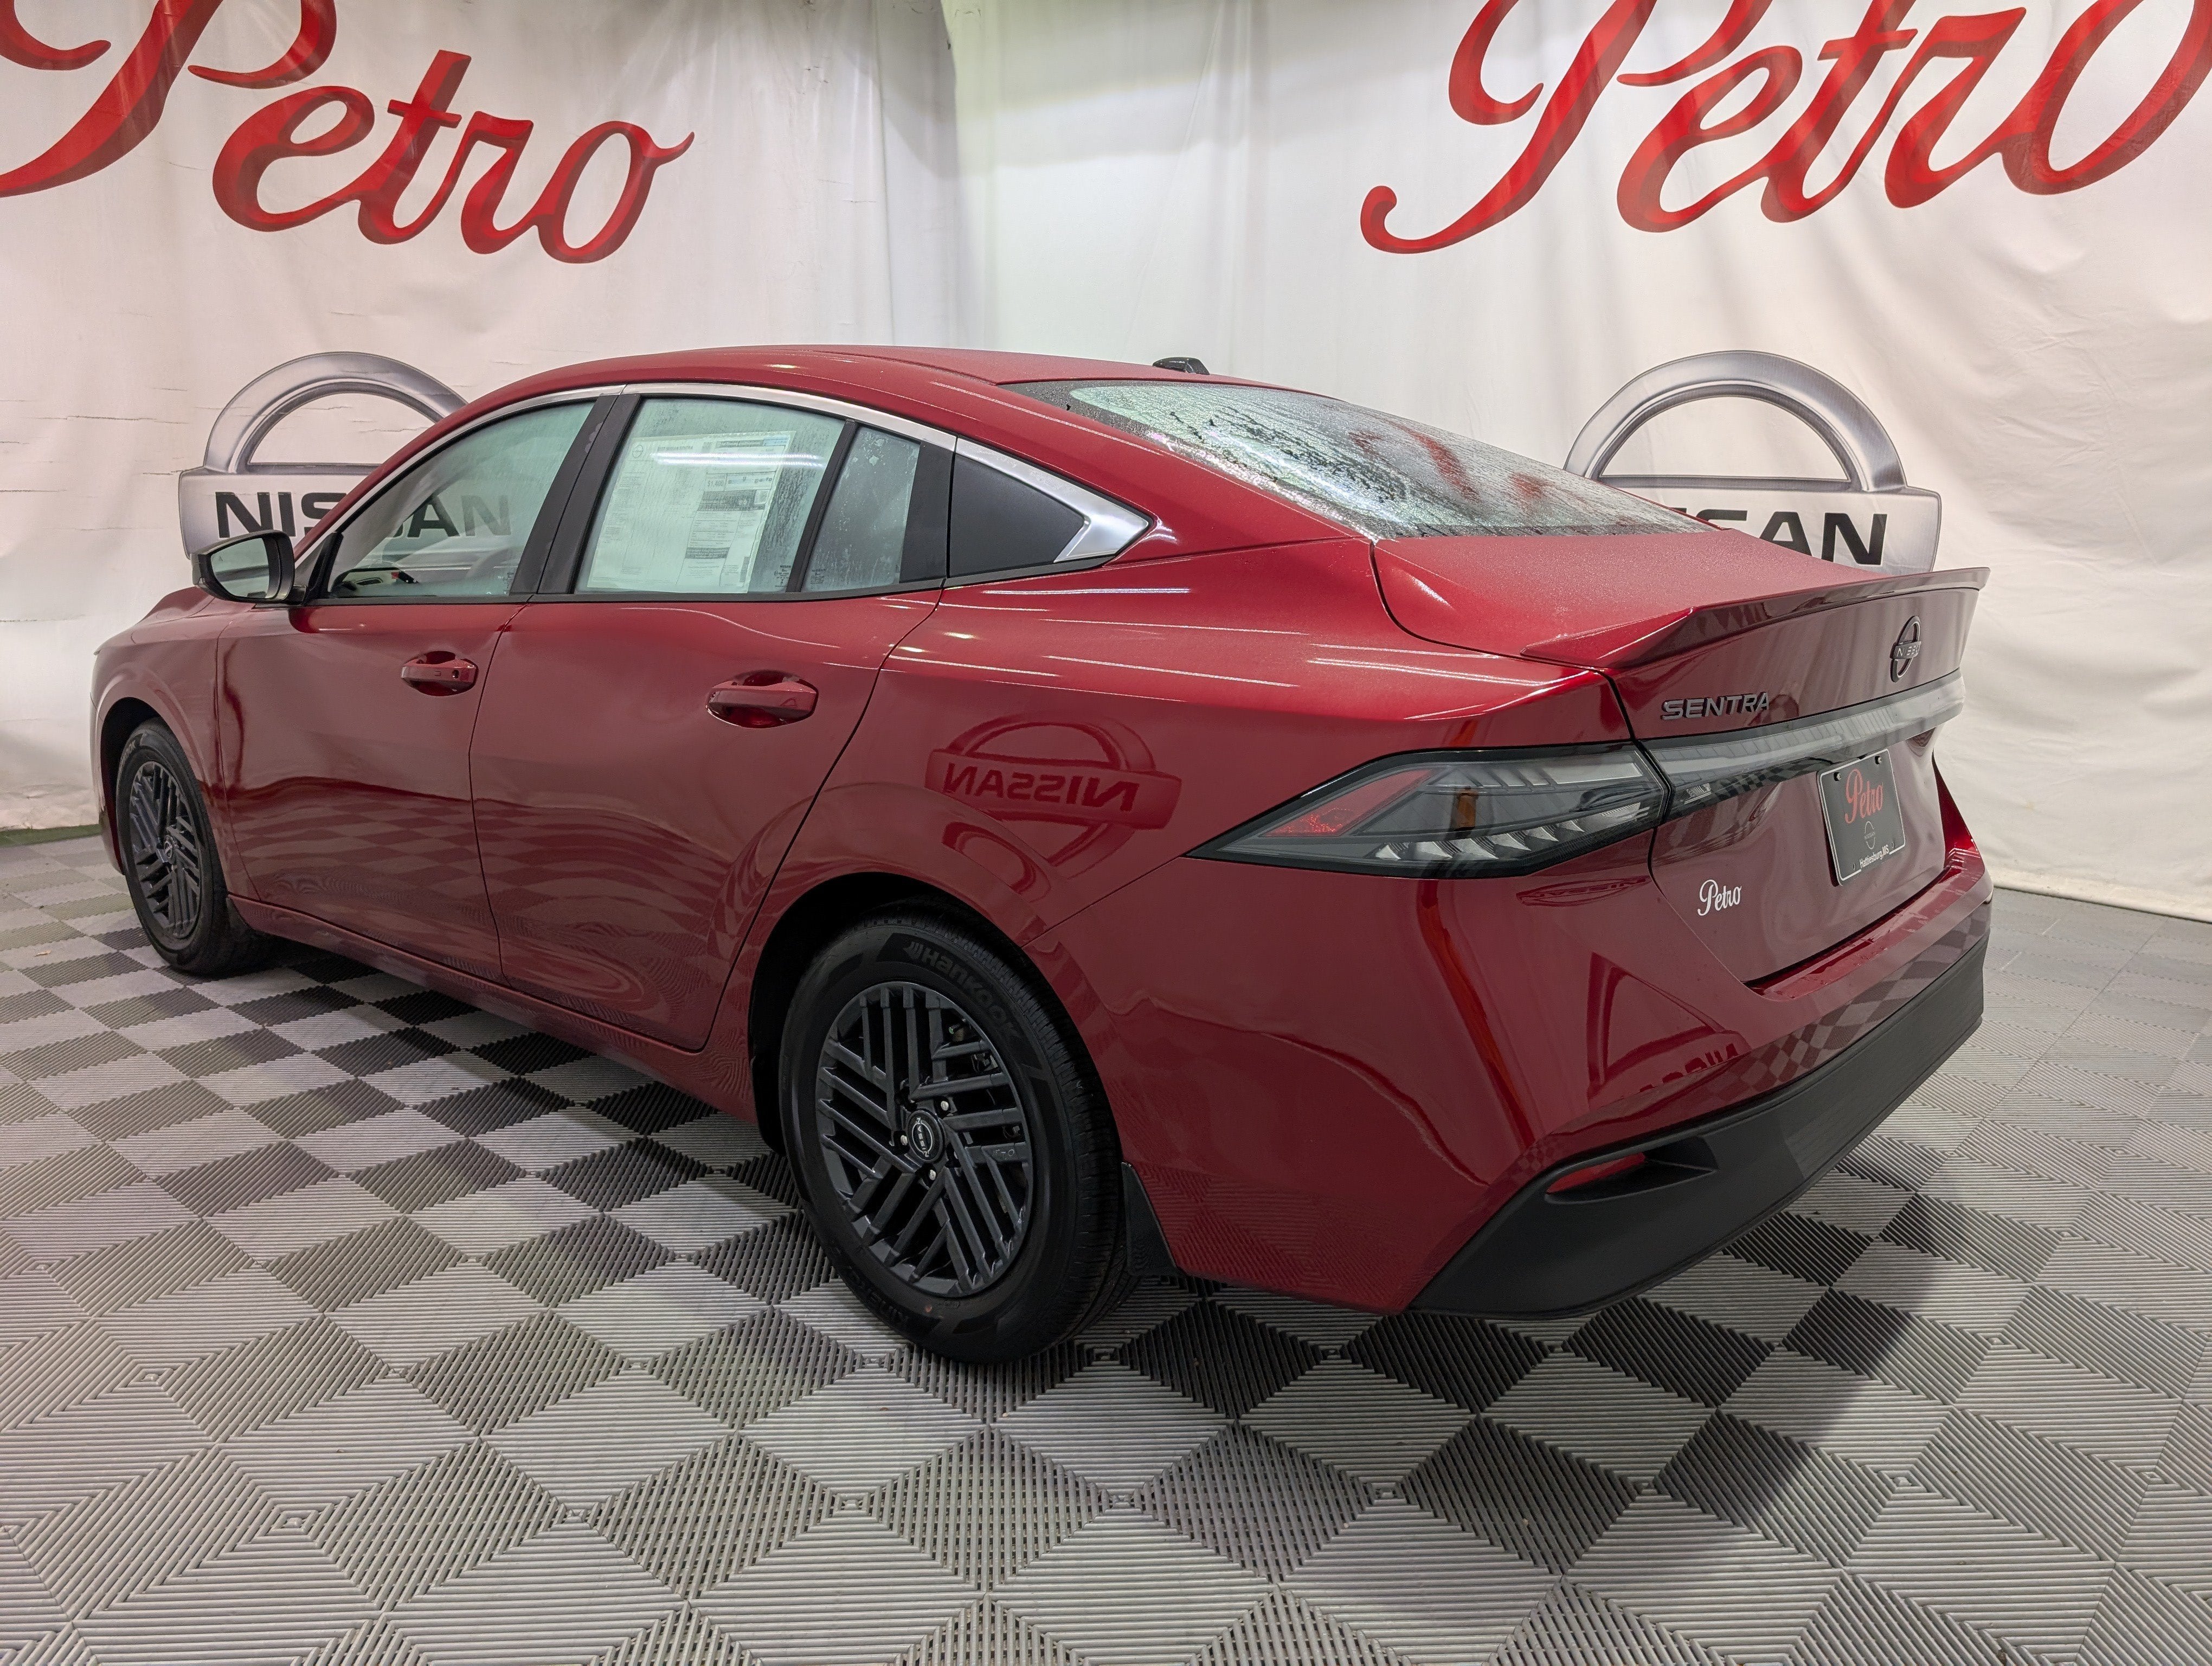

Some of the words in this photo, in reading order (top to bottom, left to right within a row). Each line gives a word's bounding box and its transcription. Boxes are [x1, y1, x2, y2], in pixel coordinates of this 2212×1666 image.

[0, 0, 695, 265] Petro
[1360, 0, 2212, 254] Petro
[215, 491, 512, 538] NISAN
[1660, 691, 1769, 720] SENTRA
[1844, 768, 1883, 824] Petro
[1697, 879, 1742, 916] Petro
